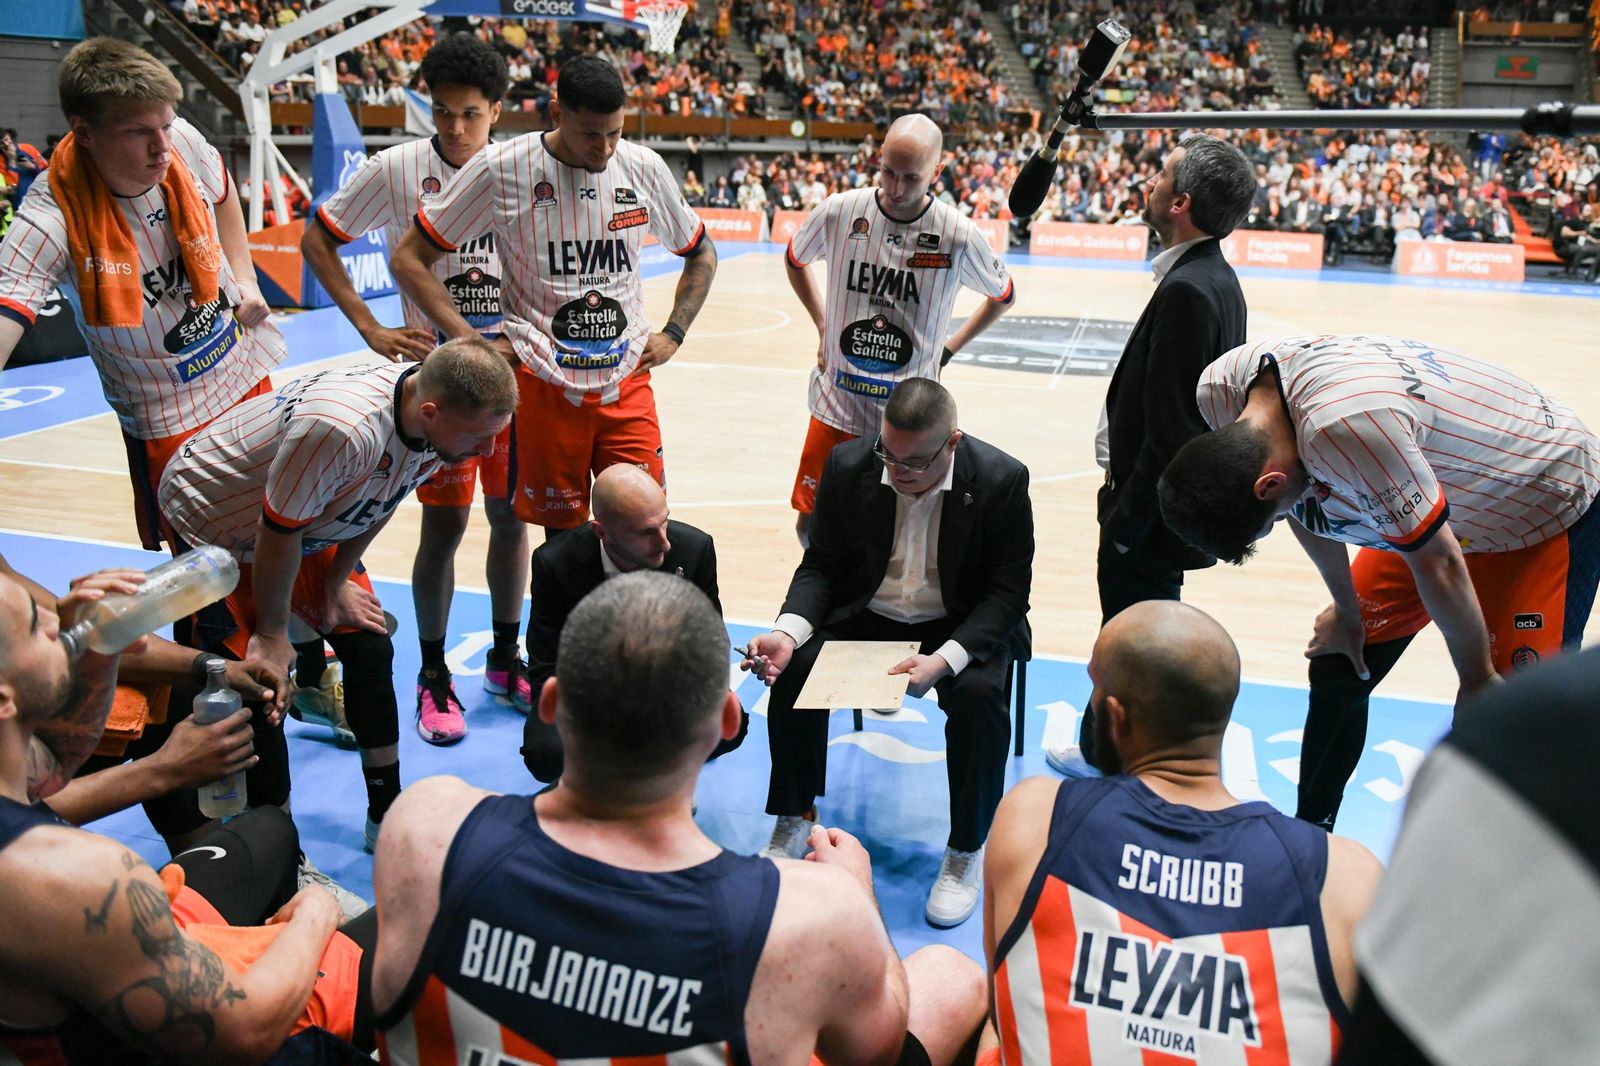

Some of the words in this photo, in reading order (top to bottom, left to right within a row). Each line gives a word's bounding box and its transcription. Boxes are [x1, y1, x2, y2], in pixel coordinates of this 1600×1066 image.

[460, 256, 489, 264] NATURA
[548, 239, 632, 275] LEYMA
[341, 252, 393, 294] EYMA
[580, 277, 610, 286] NATURA
[847, 259, 920, 304] LEYMA
[450, 284, 500, 299] Estrella
[869, 297, 895, 309] NATURA
[566, 308, 617, 324] Estrella
[568, 323, 617, 338] Galicia
[851, 327, 902, 348] Estrella
[187, 335, 232, 378] Aluman
[561, 353, 620, 366] Aluman
[852, 341, 897, 361] Galicia
[839, 376, 888, 395] Aluman
[1516, 620, 1537, 628] acb
[1117, 843, 1245, 908] SCRUBB
[460, 917, 703, 1037] BURJANADZE
[1073, 931, 1256, 1041] LEYMA
[1126, 1022, 1196, 1054] NATURA
